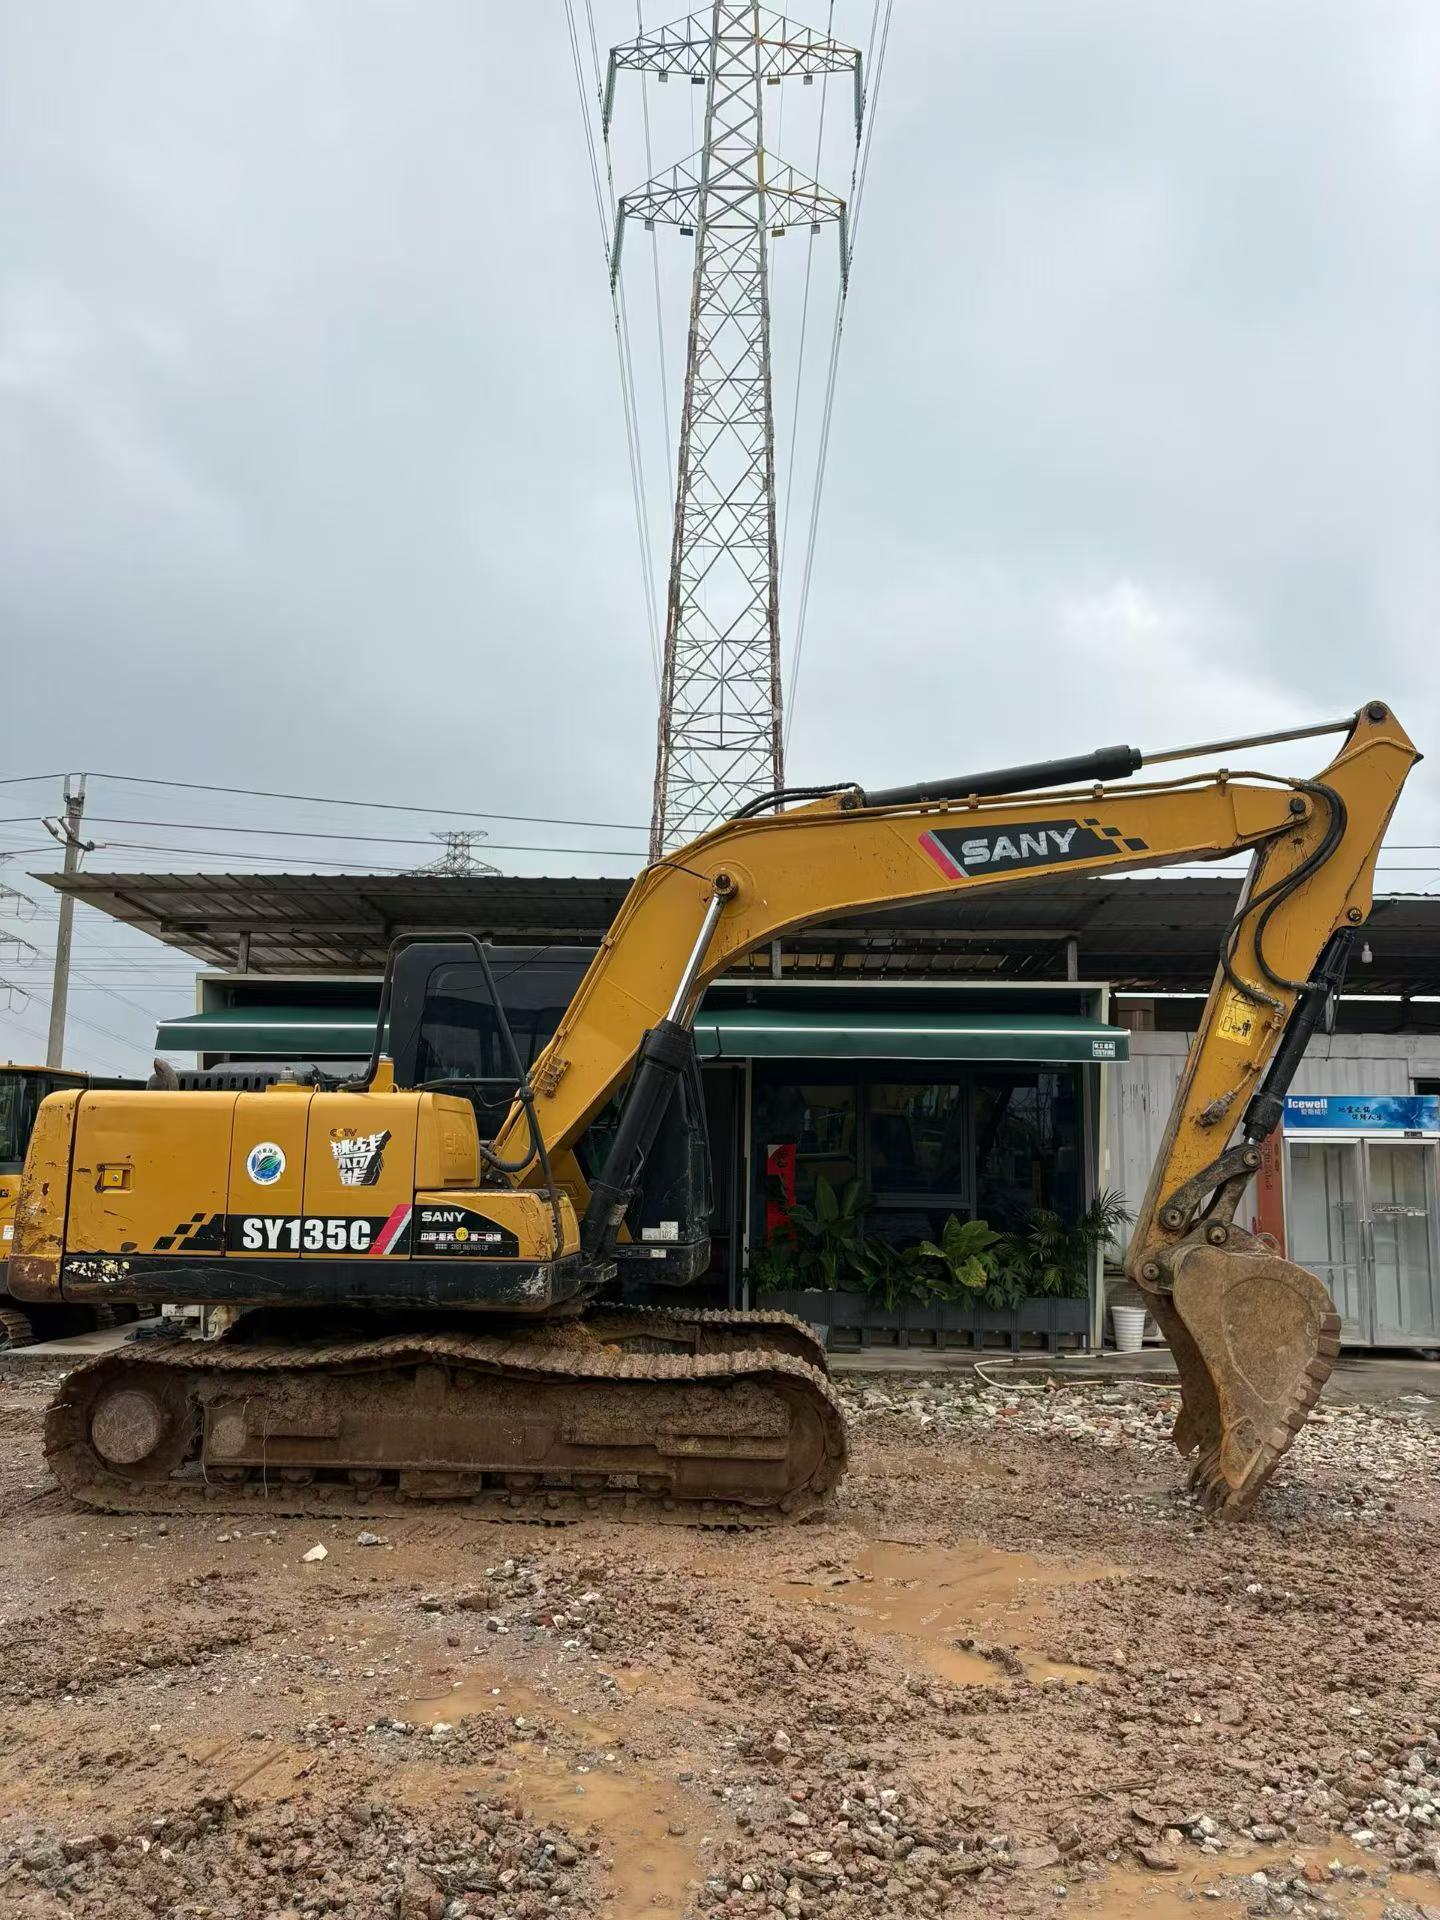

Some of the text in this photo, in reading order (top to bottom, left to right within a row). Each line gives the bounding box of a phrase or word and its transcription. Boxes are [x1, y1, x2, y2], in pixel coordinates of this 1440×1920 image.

[961, 827, 1077, 865] SANY
[1287, 1098, 1328, 1109] Icewell
[330, 1128, 357, 1138] CCTV
[421, 1211, 466, 1223] SANY
[242, 1217, 371, 1251] SY135C
